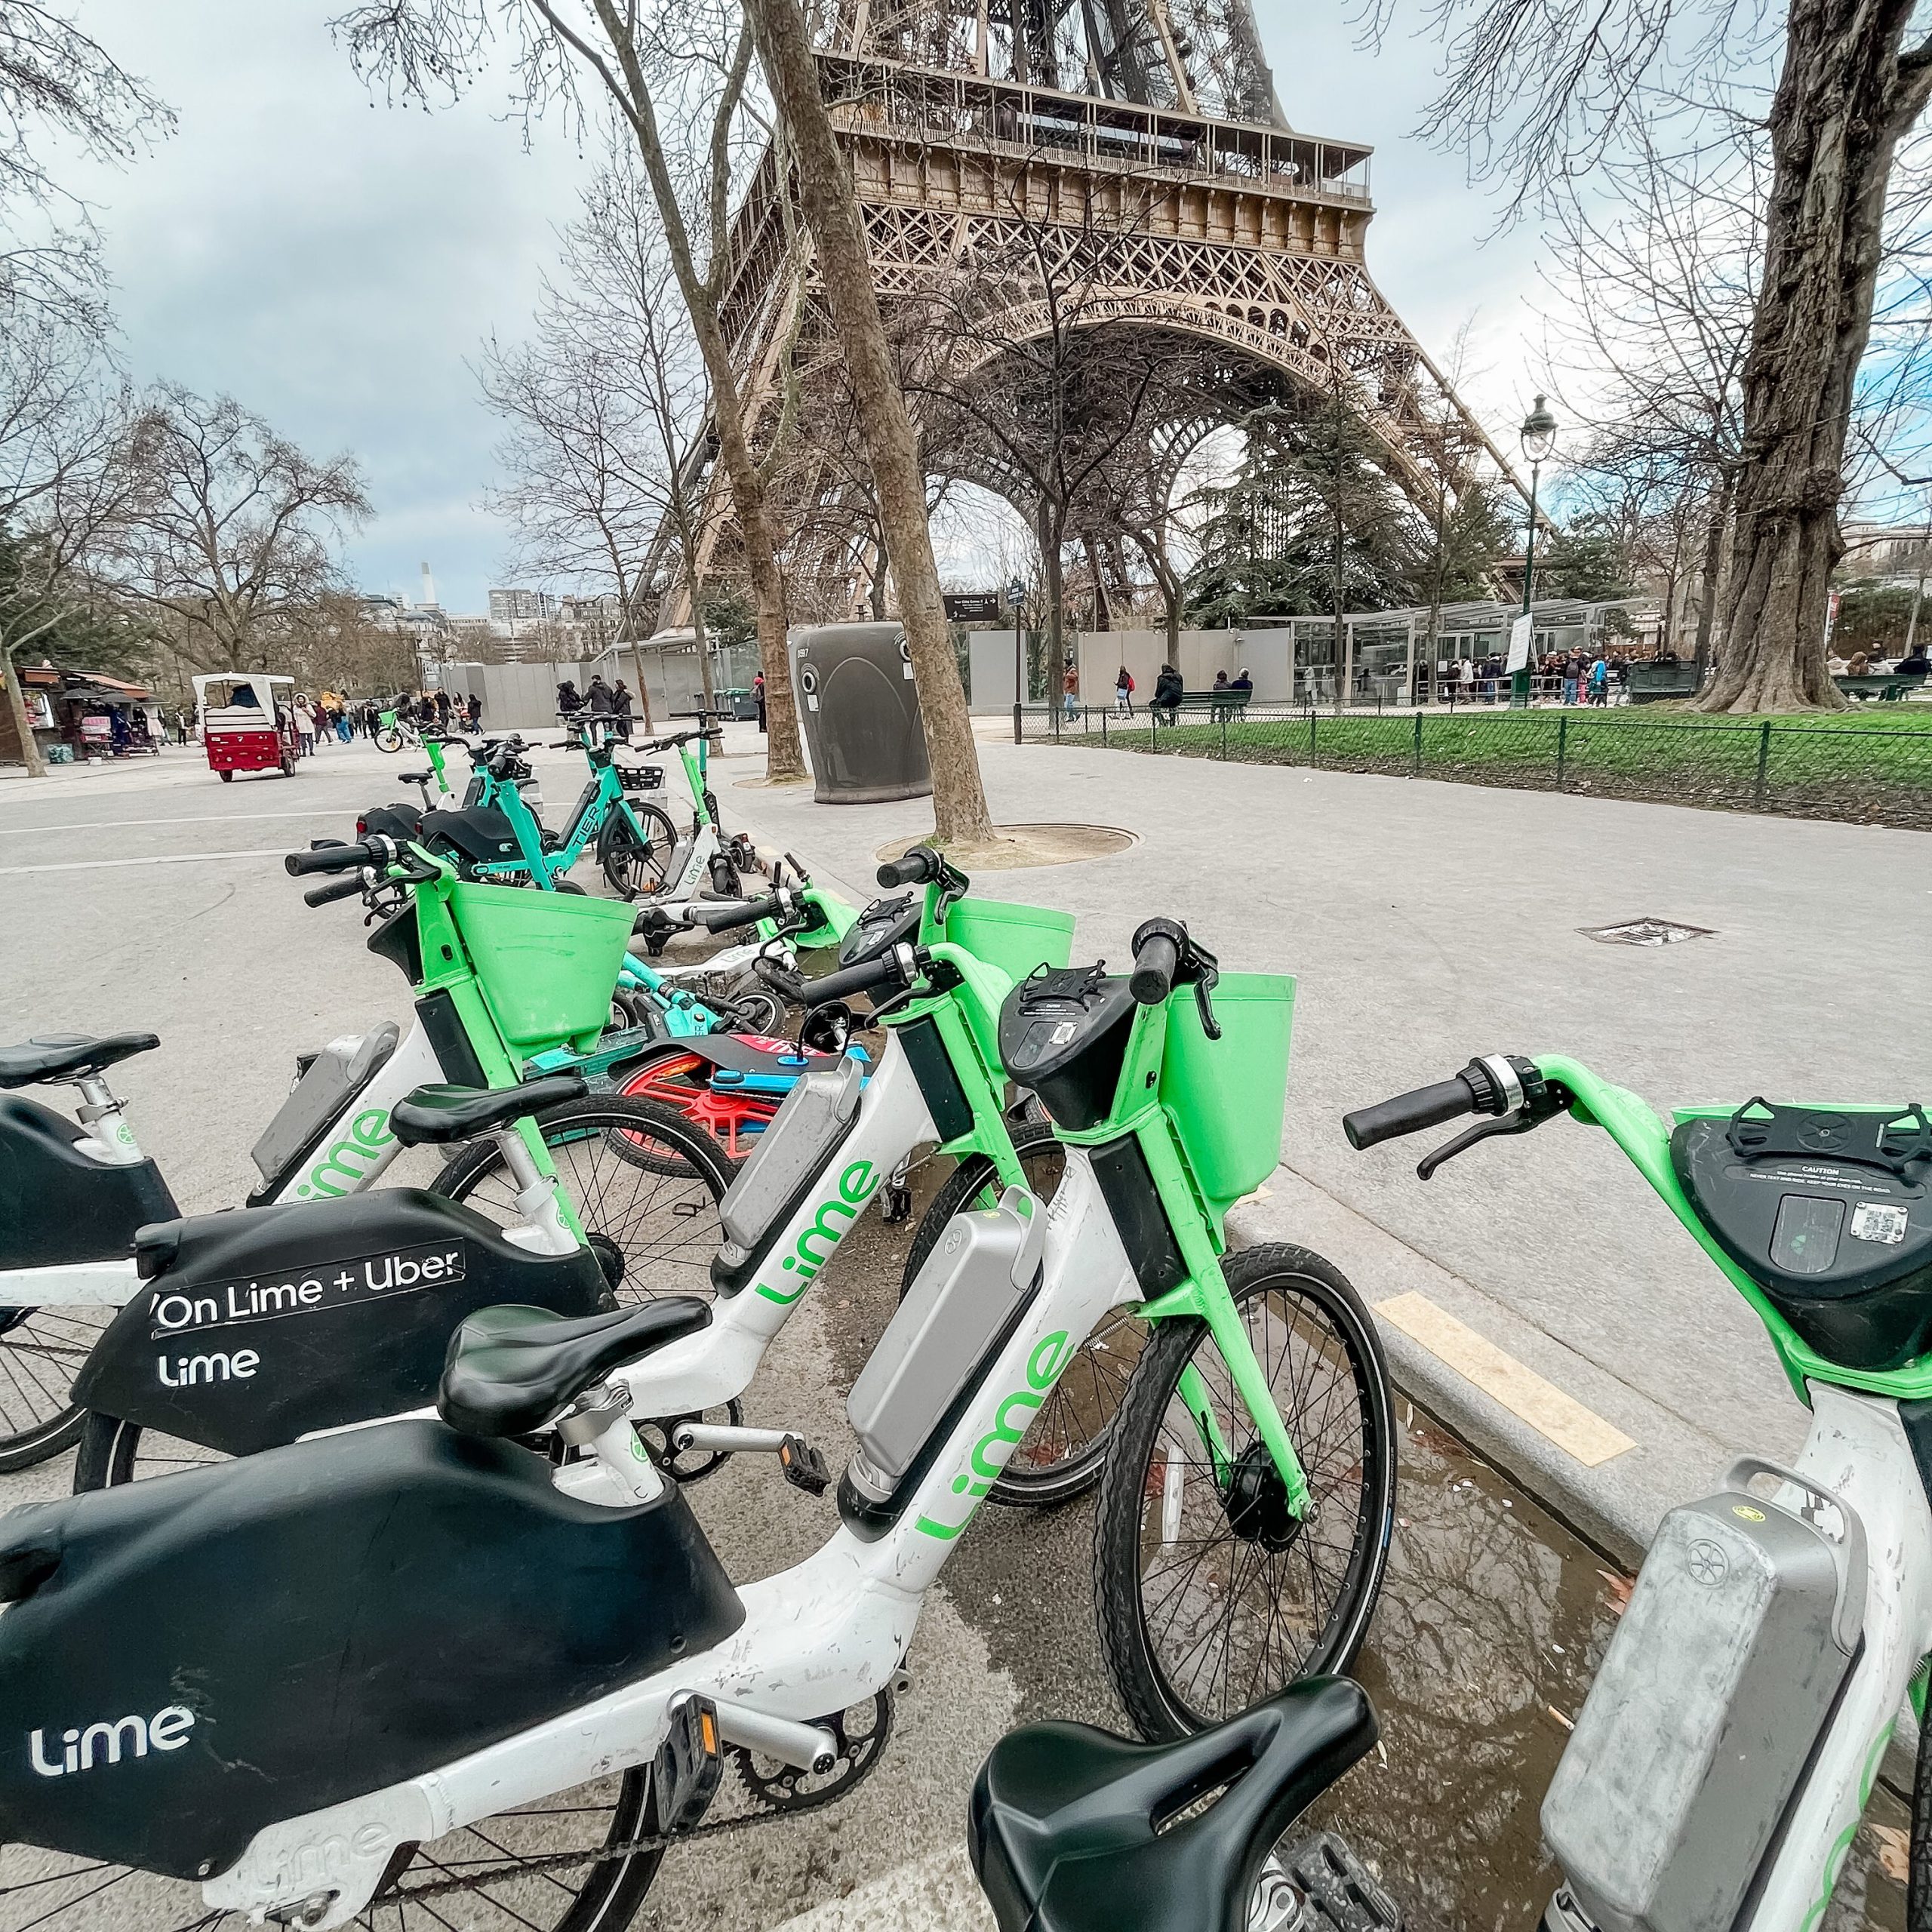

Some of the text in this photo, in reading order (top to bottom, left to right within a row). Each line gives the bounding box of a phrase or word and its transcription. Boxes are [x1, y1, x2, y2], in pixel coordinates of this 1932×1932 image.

[572, 806, 600, 847] TIER
[684, 855, 706, 885] Lime
[720, 949, 755, 962] Lime
[297, 1109, 396, 1200] ime
[1801, 1165, 1840, 1176] CAUTION
[755, 1160, 881, 1305] Lime
[227, 1278, 324, 1318] Lime
[365, 1252, 459, 1291] Uber
[158, 1349, 260, 1387] Lime
[914, 1331, 1075, 1540] Lime
[31, 1706, 195, 1777] Lime
[256, 1822, 392, 1890] Lime
